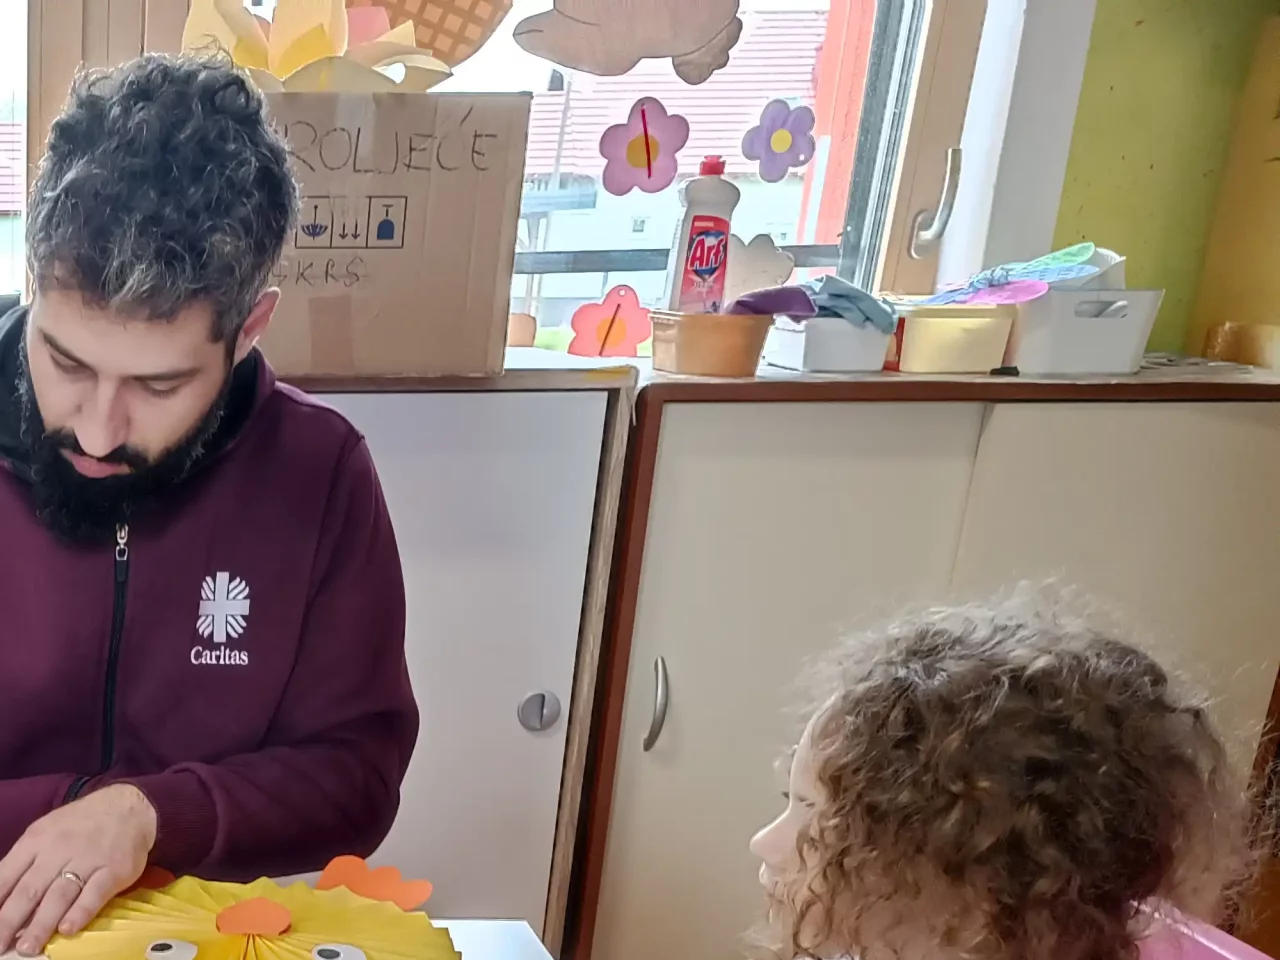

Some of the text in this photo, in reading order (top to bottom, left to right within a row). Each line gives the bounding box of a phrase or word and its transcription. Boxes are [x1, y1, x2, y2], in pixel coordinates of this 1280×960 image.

[274, 104, 498, 174] ROLJEĆE
[687, 235, 726, 270] Arf
[268, 256, 364, 287] SKRS
[190, 645, 249, 665] Caritas
